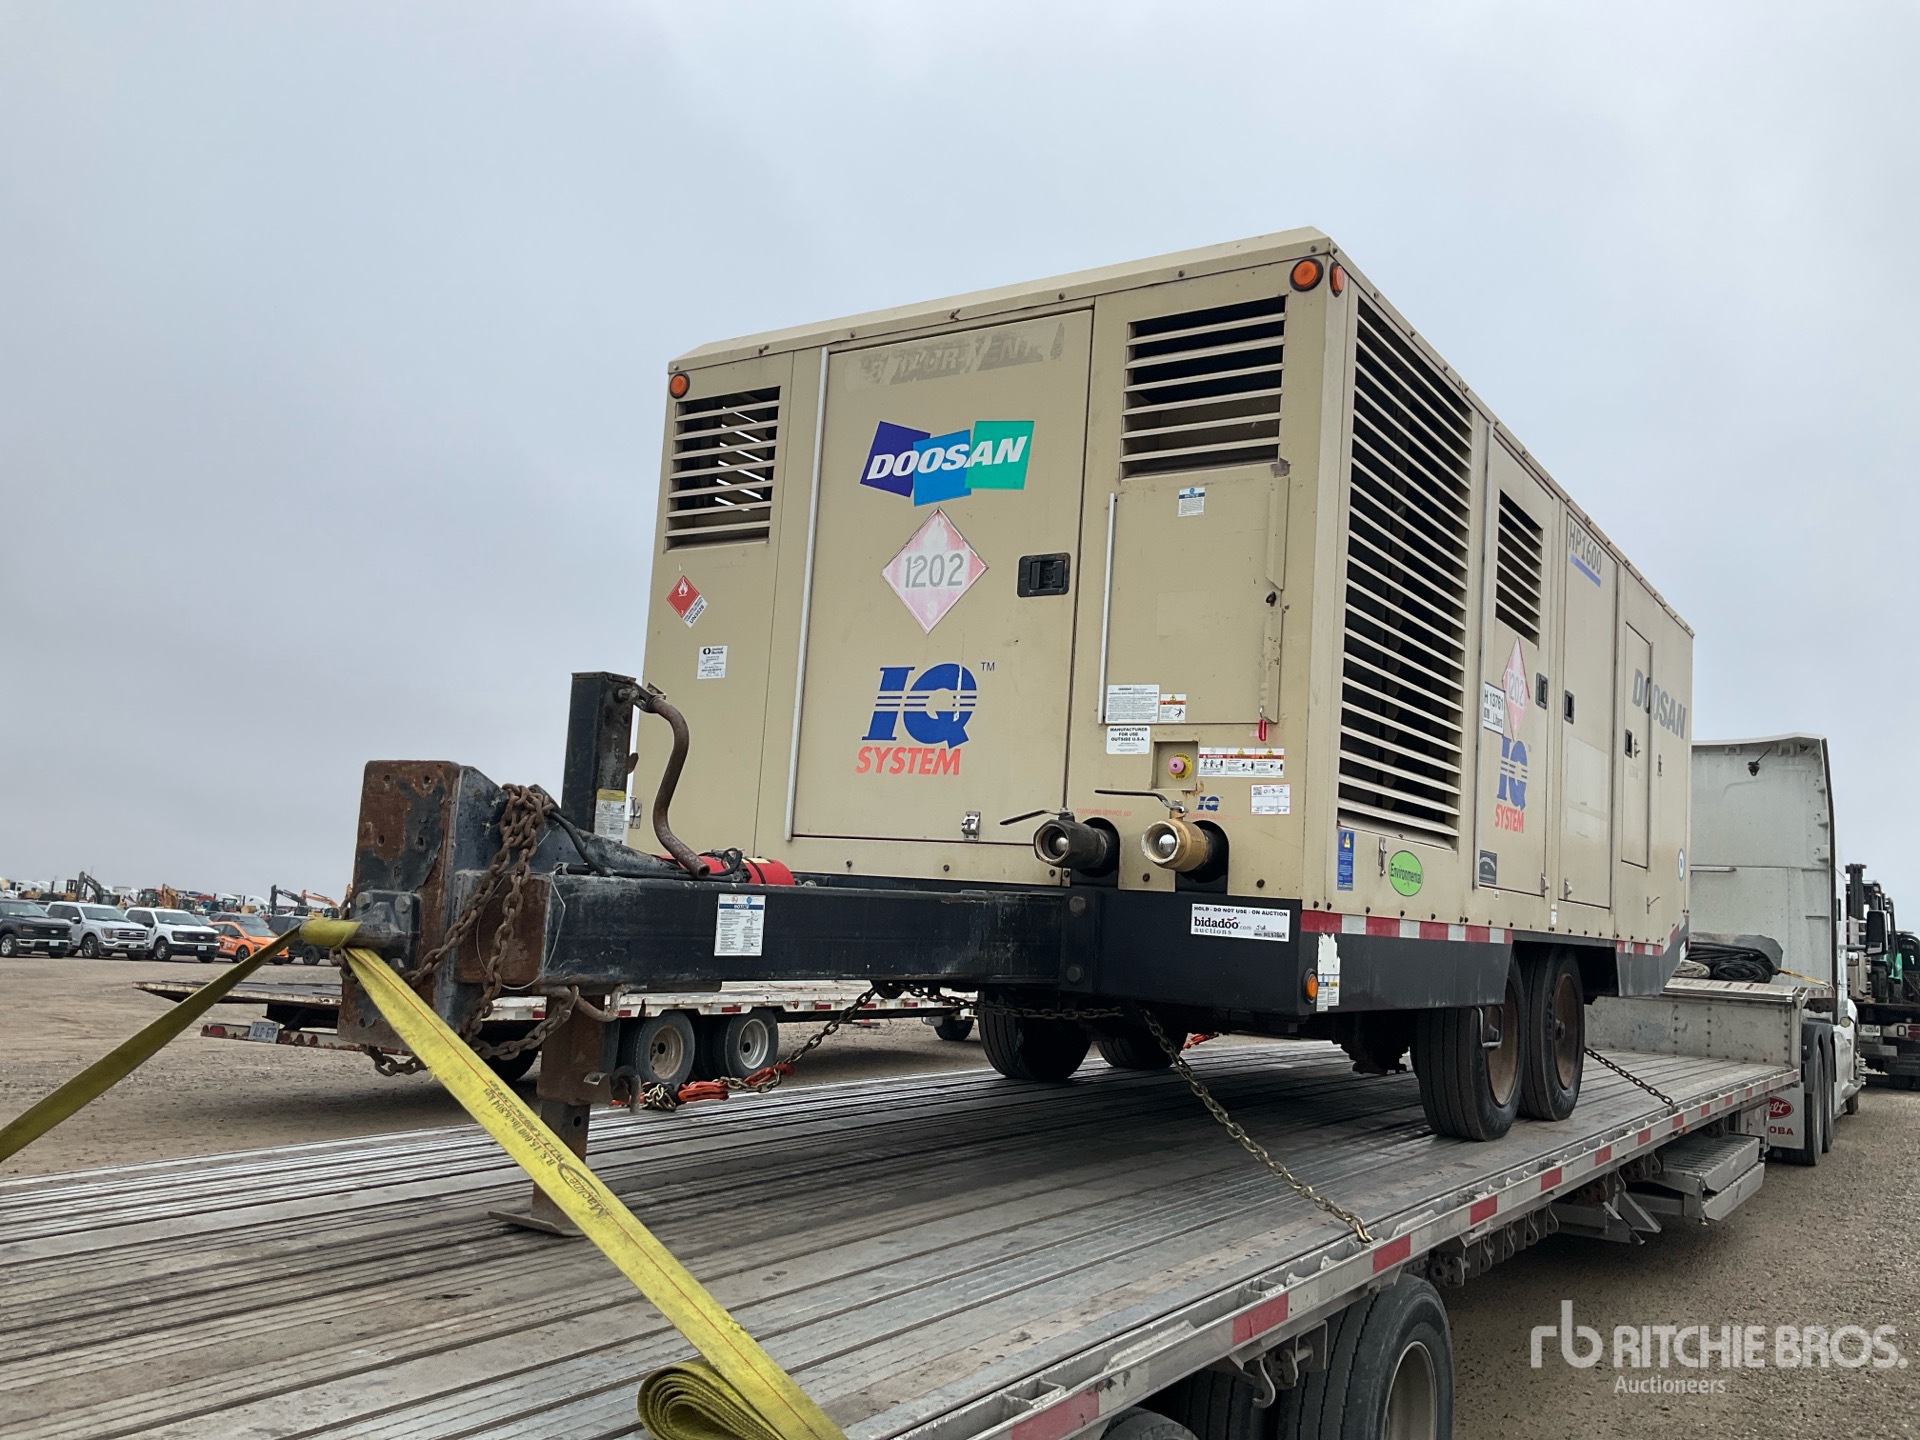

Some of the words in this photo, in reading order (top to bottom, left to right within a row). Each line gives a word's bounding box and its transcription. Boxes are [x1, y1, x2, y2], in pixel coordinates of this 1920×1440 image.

[866, 436, 1028, 480] DOOSAN
[1568, 522, 1602, 575] HP1600
[905, 552, 965, 588] 1202
[861, 663, 977, 749] IQ
[1632, 667, 1687, 740] DOOSAN
[854, 746, 962, 776] SYSTEM
[1497, 735, 1528, 811] IQ
[1197, 796, 1220, 812] IQ
[1494, 803, 1524, 834] SYSTEM
[1390, 863, 1422, 884] Environmental
[1194, 916, 1239, 929] bidadoo
